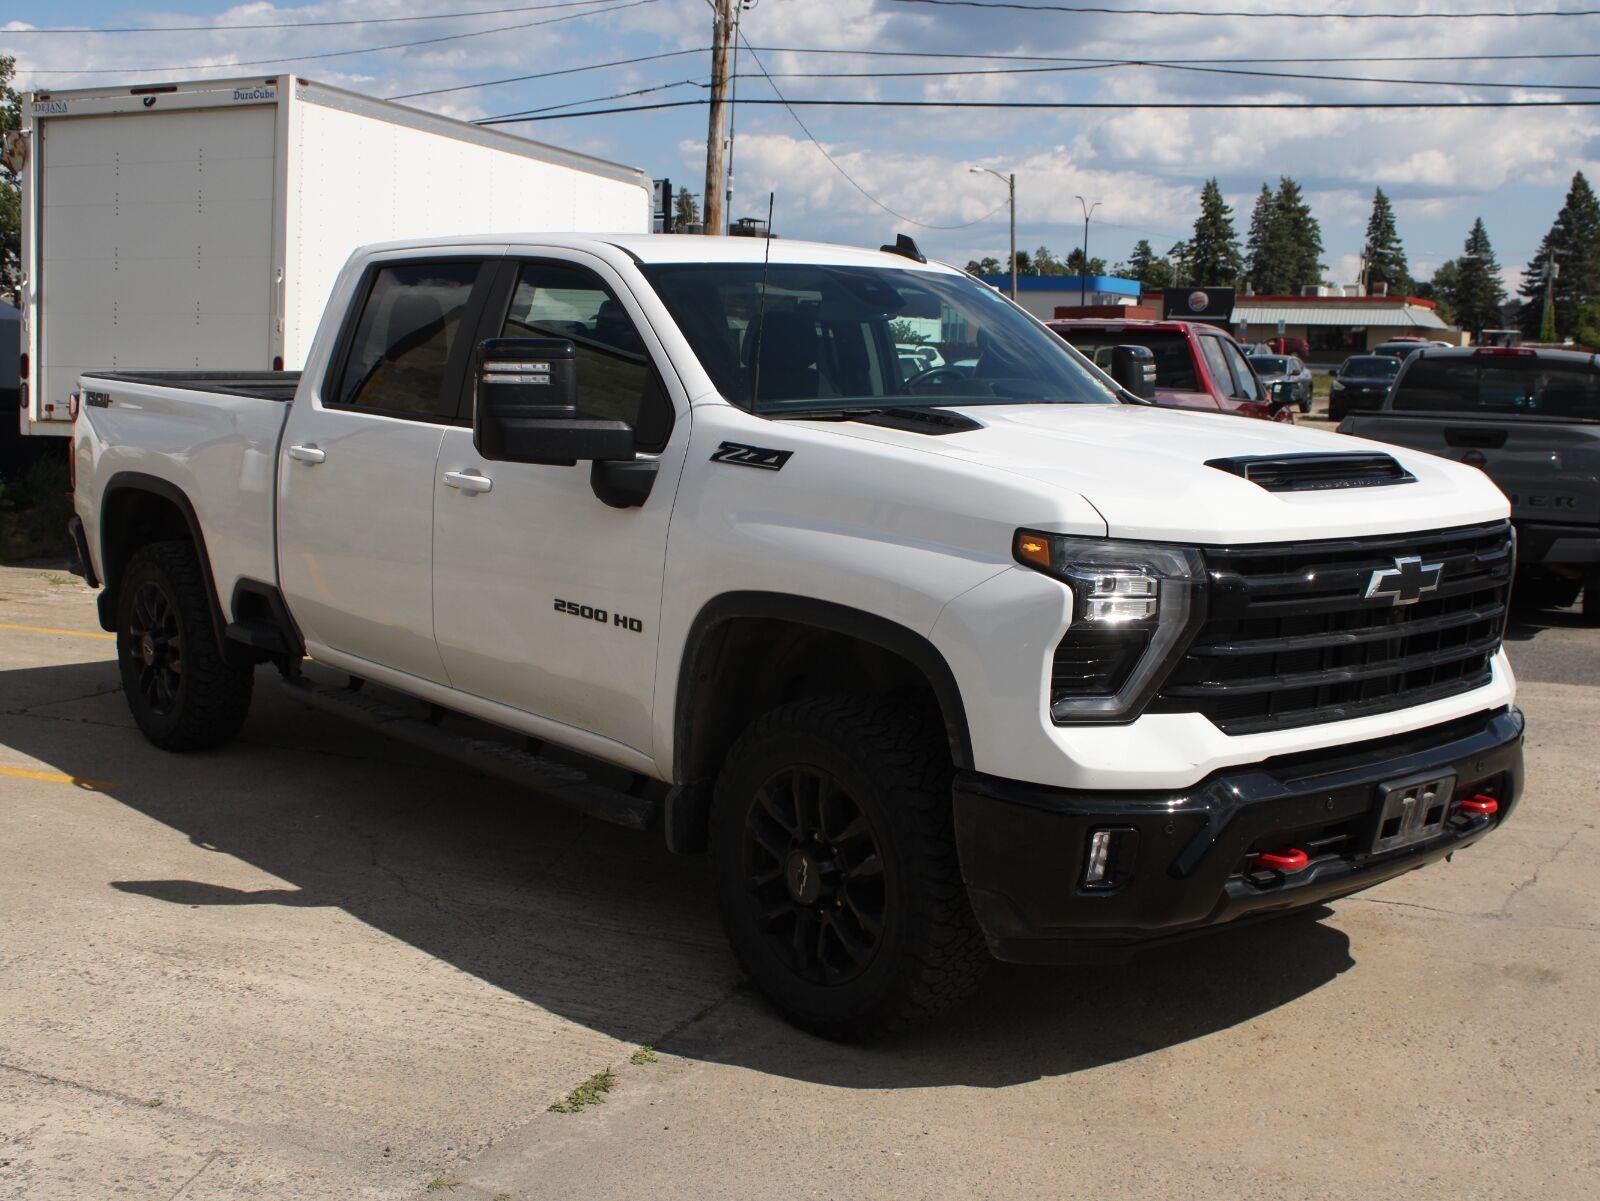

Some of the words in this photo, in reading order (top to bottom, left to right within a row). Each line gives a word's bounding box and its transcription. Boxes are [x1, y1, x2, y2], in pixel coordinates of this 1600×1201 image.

[233, 89, 275, 100] DuraCube
[35, 103, 68, 113] DEJANA
[554, 598, 608, 623] 2500
[614, 613, 642, 633] HD
